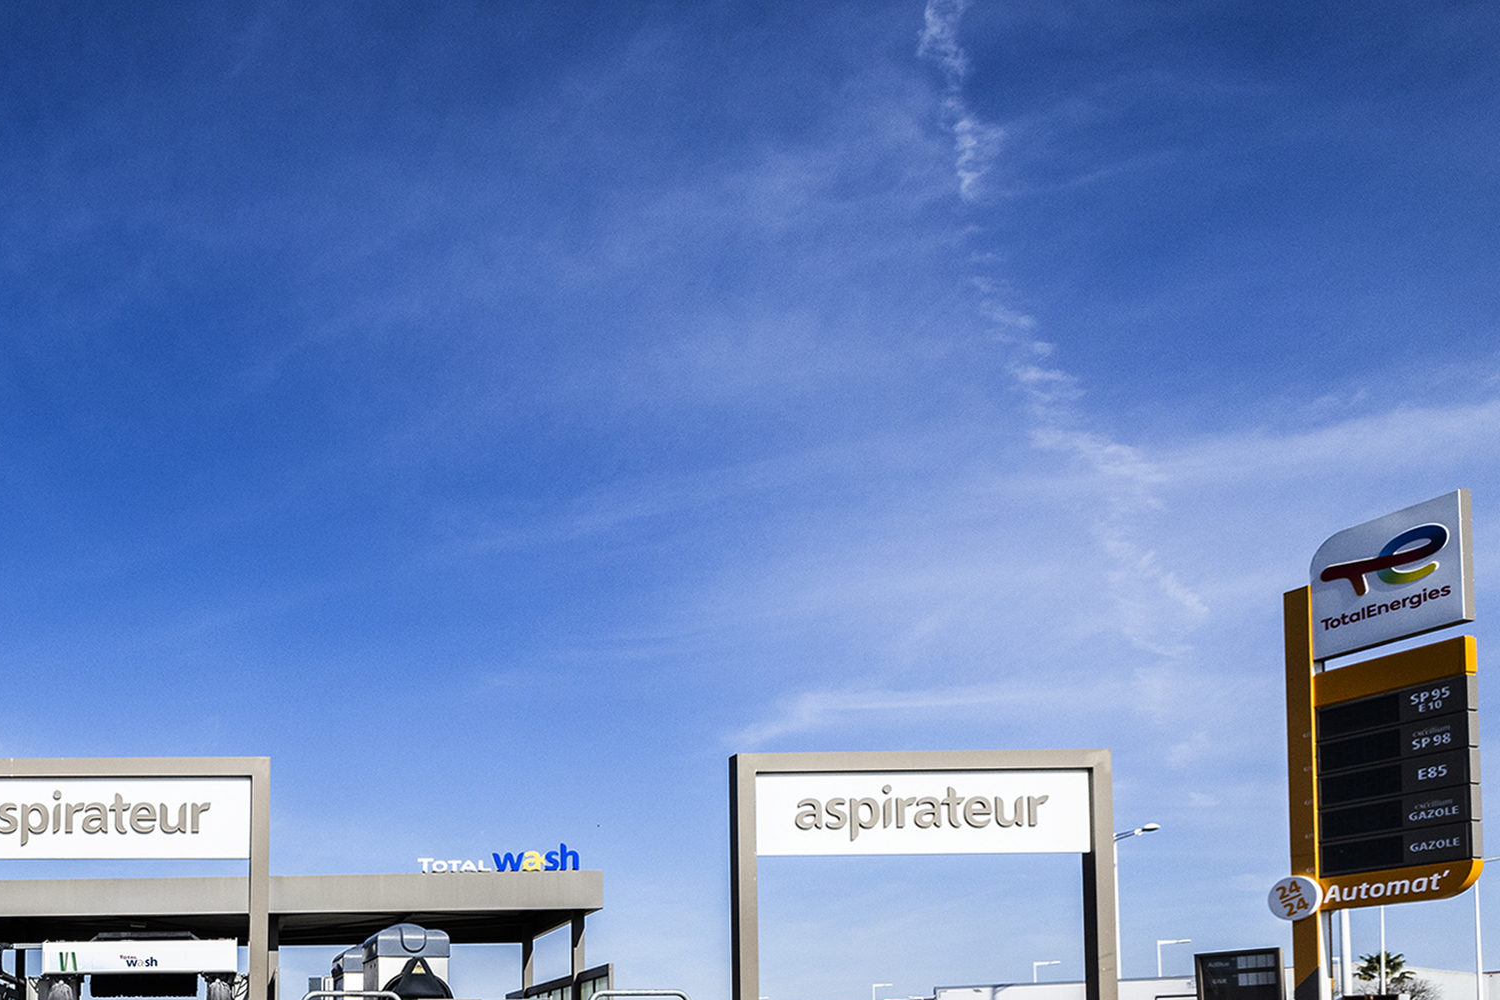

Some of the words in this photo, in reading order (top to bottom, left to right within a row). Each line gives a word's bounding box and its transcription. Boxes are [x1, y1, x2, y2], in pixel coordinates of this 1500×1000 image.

[1320, 585, 1452, 632] TotalEnergies
[1411, 737, 1431, 751] SP
[1432, 732, 1452, 747] 98
[1417, 764, 1448, 781] E85
[795, 784, 1049, 842] aspirateur
[1408, 805, 1460, 822] GAZOLE
[1409, 837, 1461, 853] GAZOLE
[492, 842, 580, 872] wash
[1276, 880, 1302, 900] 24
[1283, 897, 1309, 917] 24
[126, 956, 158, 967] wash
